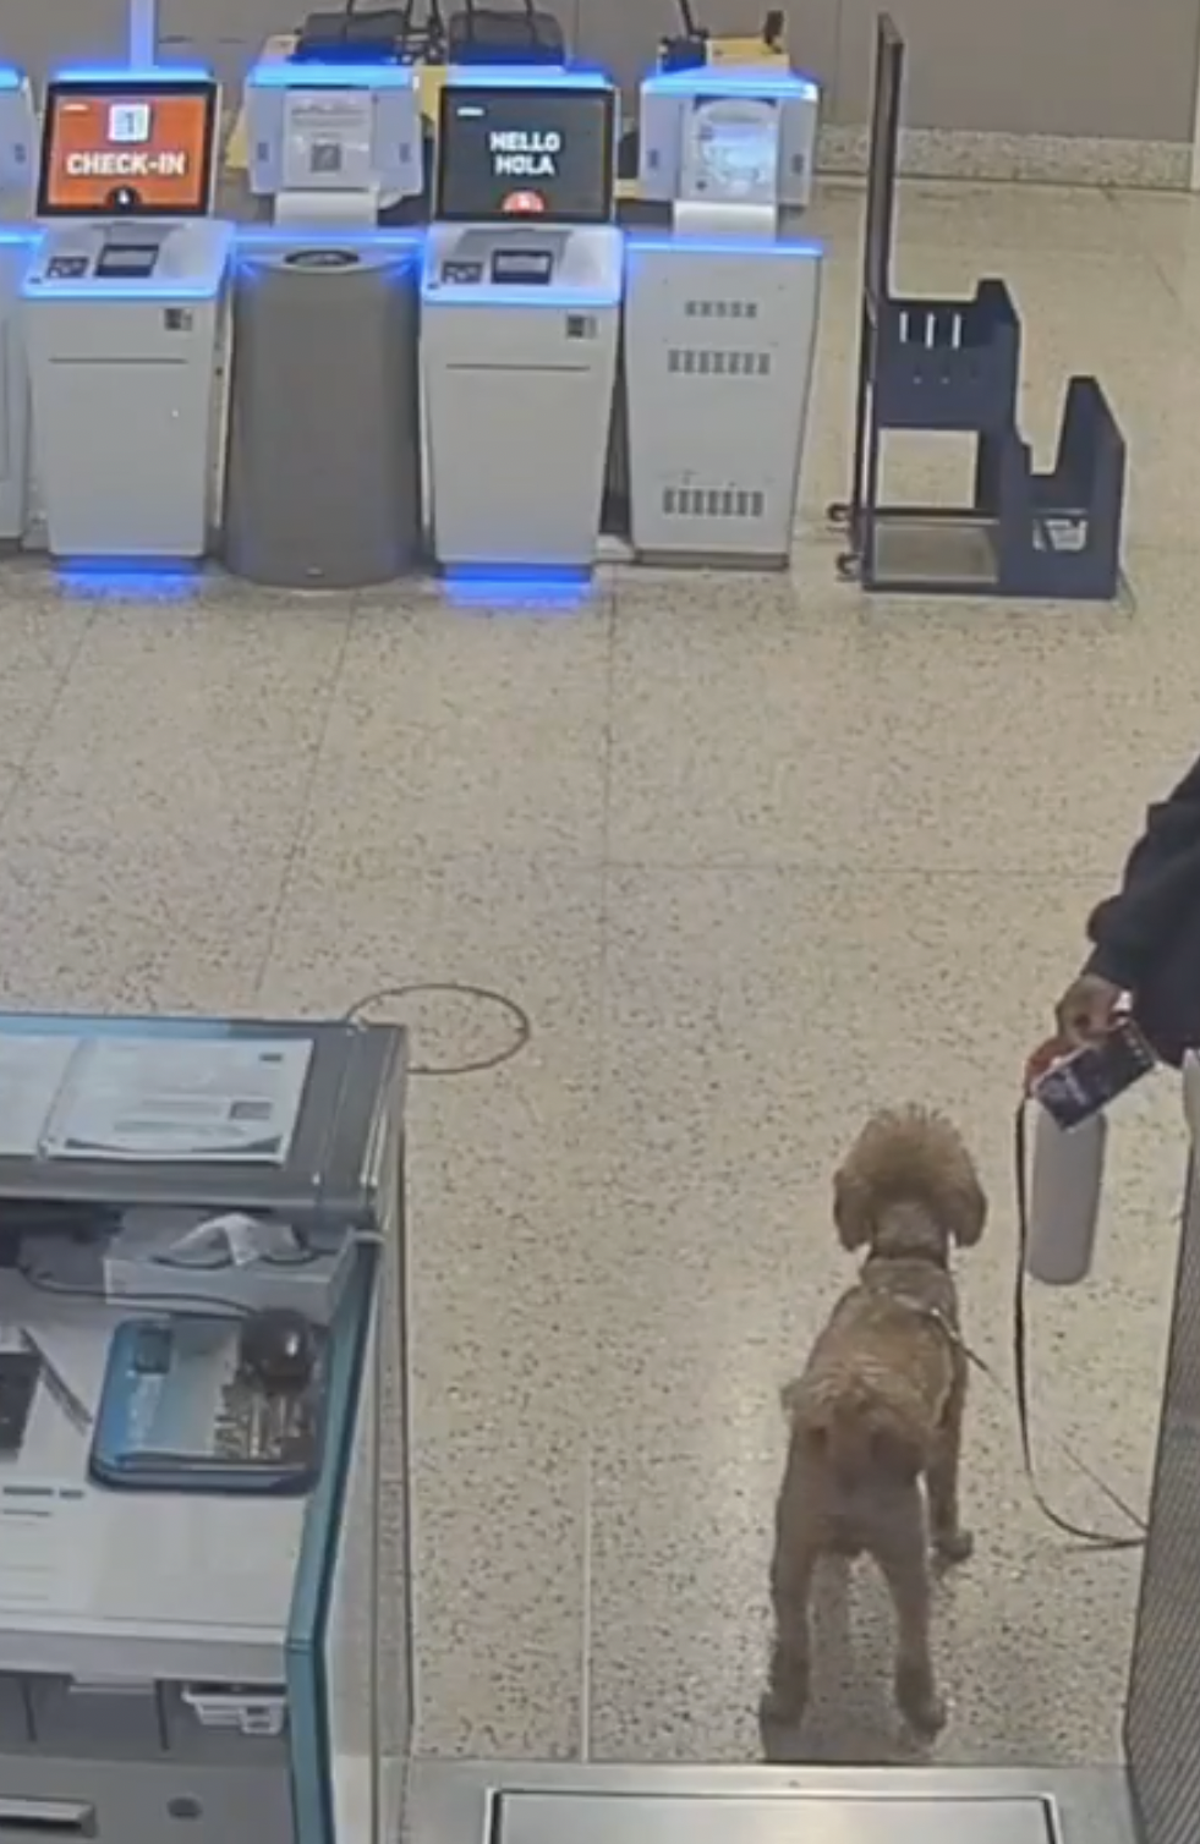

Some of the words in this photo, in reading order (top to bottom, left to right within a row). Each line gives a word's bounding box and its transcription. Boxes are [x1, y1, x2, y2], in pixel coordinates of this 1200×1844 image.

[490, 131, 561, 152] HELLO
[66, 153, 186, 175] CHECK-IN
[495, 154, 555, 175] HOLA
